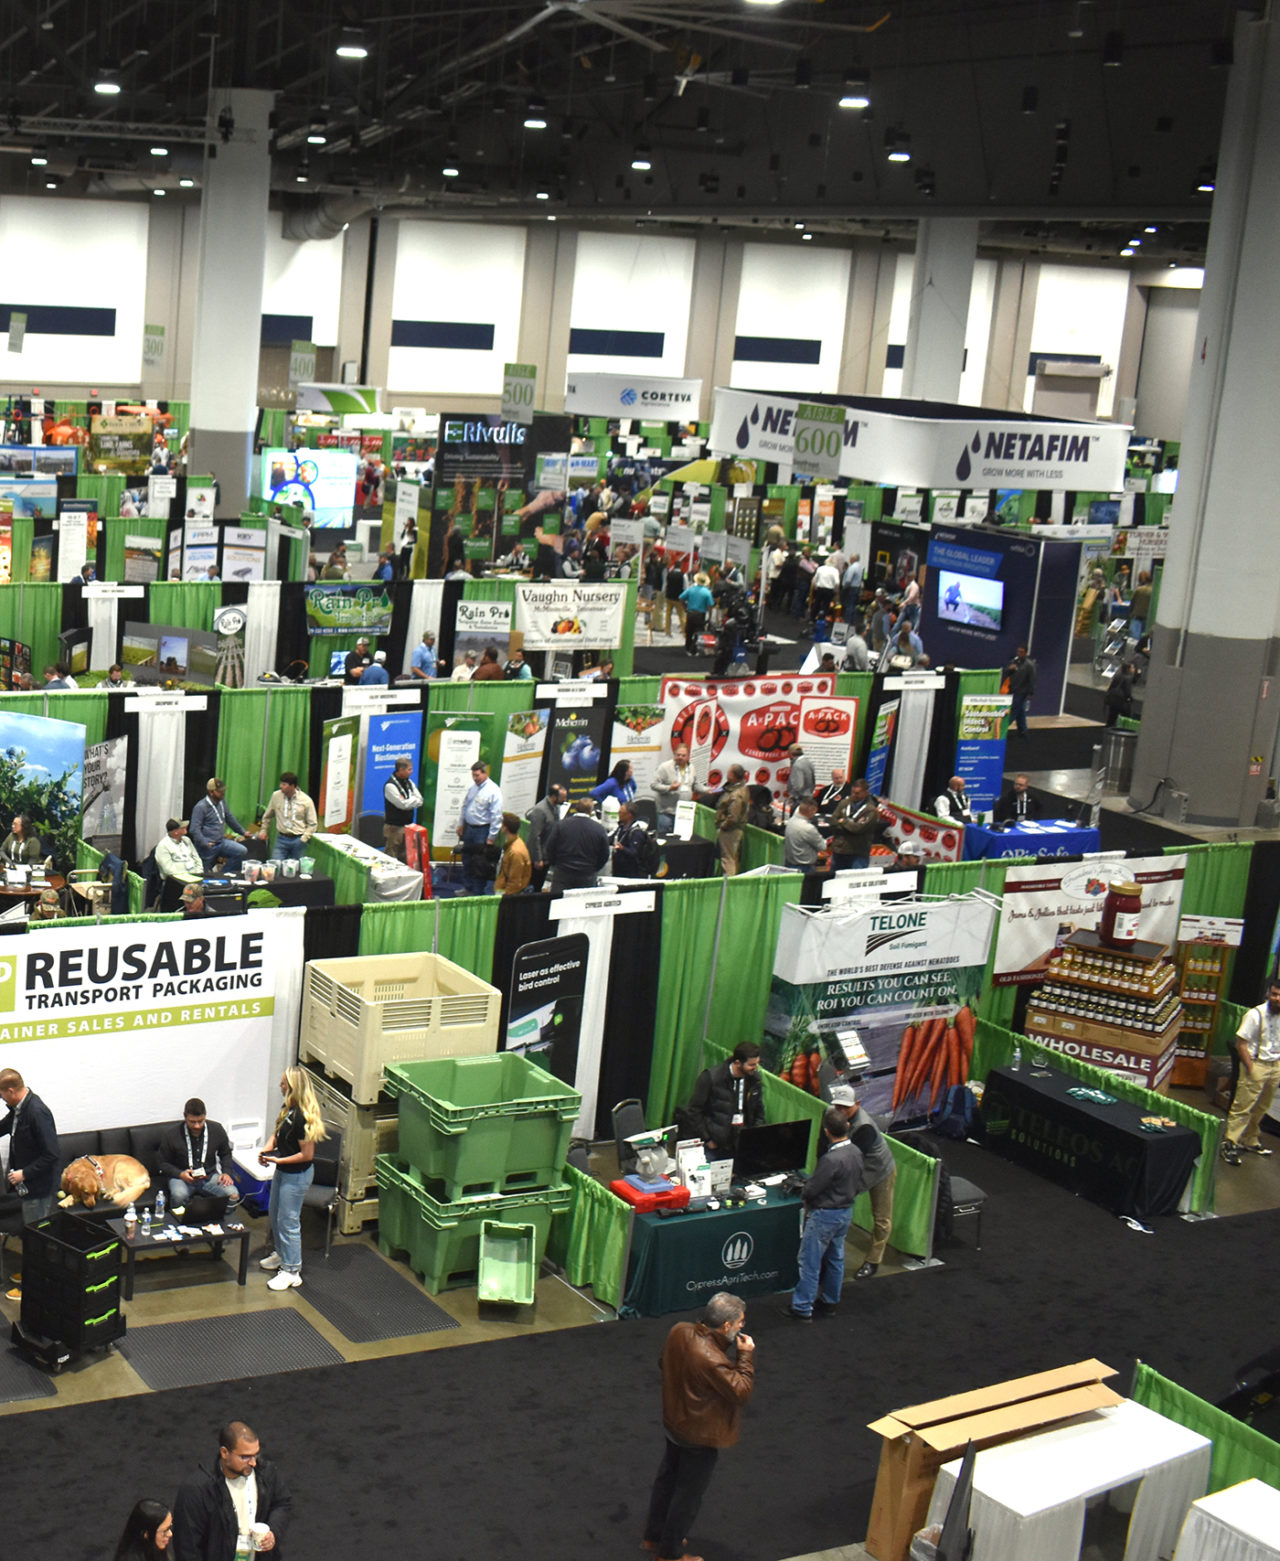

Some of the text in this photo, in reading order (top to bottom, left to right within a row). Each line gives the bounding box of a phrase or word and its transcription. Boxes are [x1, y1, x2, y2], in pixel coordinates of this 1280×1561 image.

[144, 338, 164, 356] 300
[290, 357, 314, 377] 400
[502, 382, 534, 406] 500
[641, 390, 692, 403] CORTEVA
[803, 406, 838, 421] AISLE
[778, 444, 793, 452] MOR
[795, 426, 841, 458] 600
[982, 467, 1064, 480] GROW MORE WITH LESS
[522, 588, 622, 606] Vaughn Nursery
[458, 604, 486, 620] Rain
[963, 725, 990, 733] Control
[371, 742, 417, 753] Next-Generation
[84, 760, 101, 774] YOUR
[374, 753, 412, 763] Biostimulants
[83, 771, 108, 789] STORY?
[1159, 897, 1175, 907] make
[870, 911, 928, 932] TELONE
[889, 940, 928, 951] Soil Fumigant
[25, 932, 264, 991] REUSABLE
[519, 960, 581, 981] Laser as effective
[827, 955, 960, 977] THE WORLD'S BEST DEFENSE AGAINST NEMATODES
[25, 972, 263, 1011] TRANSPORT PACKAGING
[518, 974, 560, 992] bird control
[827, 971, 953, 996] RESULTS YOU CAN SEE.
[816, 984, 958, 1011] ROI YOU CAN COUNT ON.
[67, 1016, 125, 1034] SALES
[133, 1011, 173, 1028] AND
[181, 1001, 262, 1022] RENTALS
[1028, 1032, 1152, 1072] WHOLESALE
[1010, 1128, 1077, 1168] SOLUTIONS
[685, 1271, 780, 1292] CypressAgriTech.com
